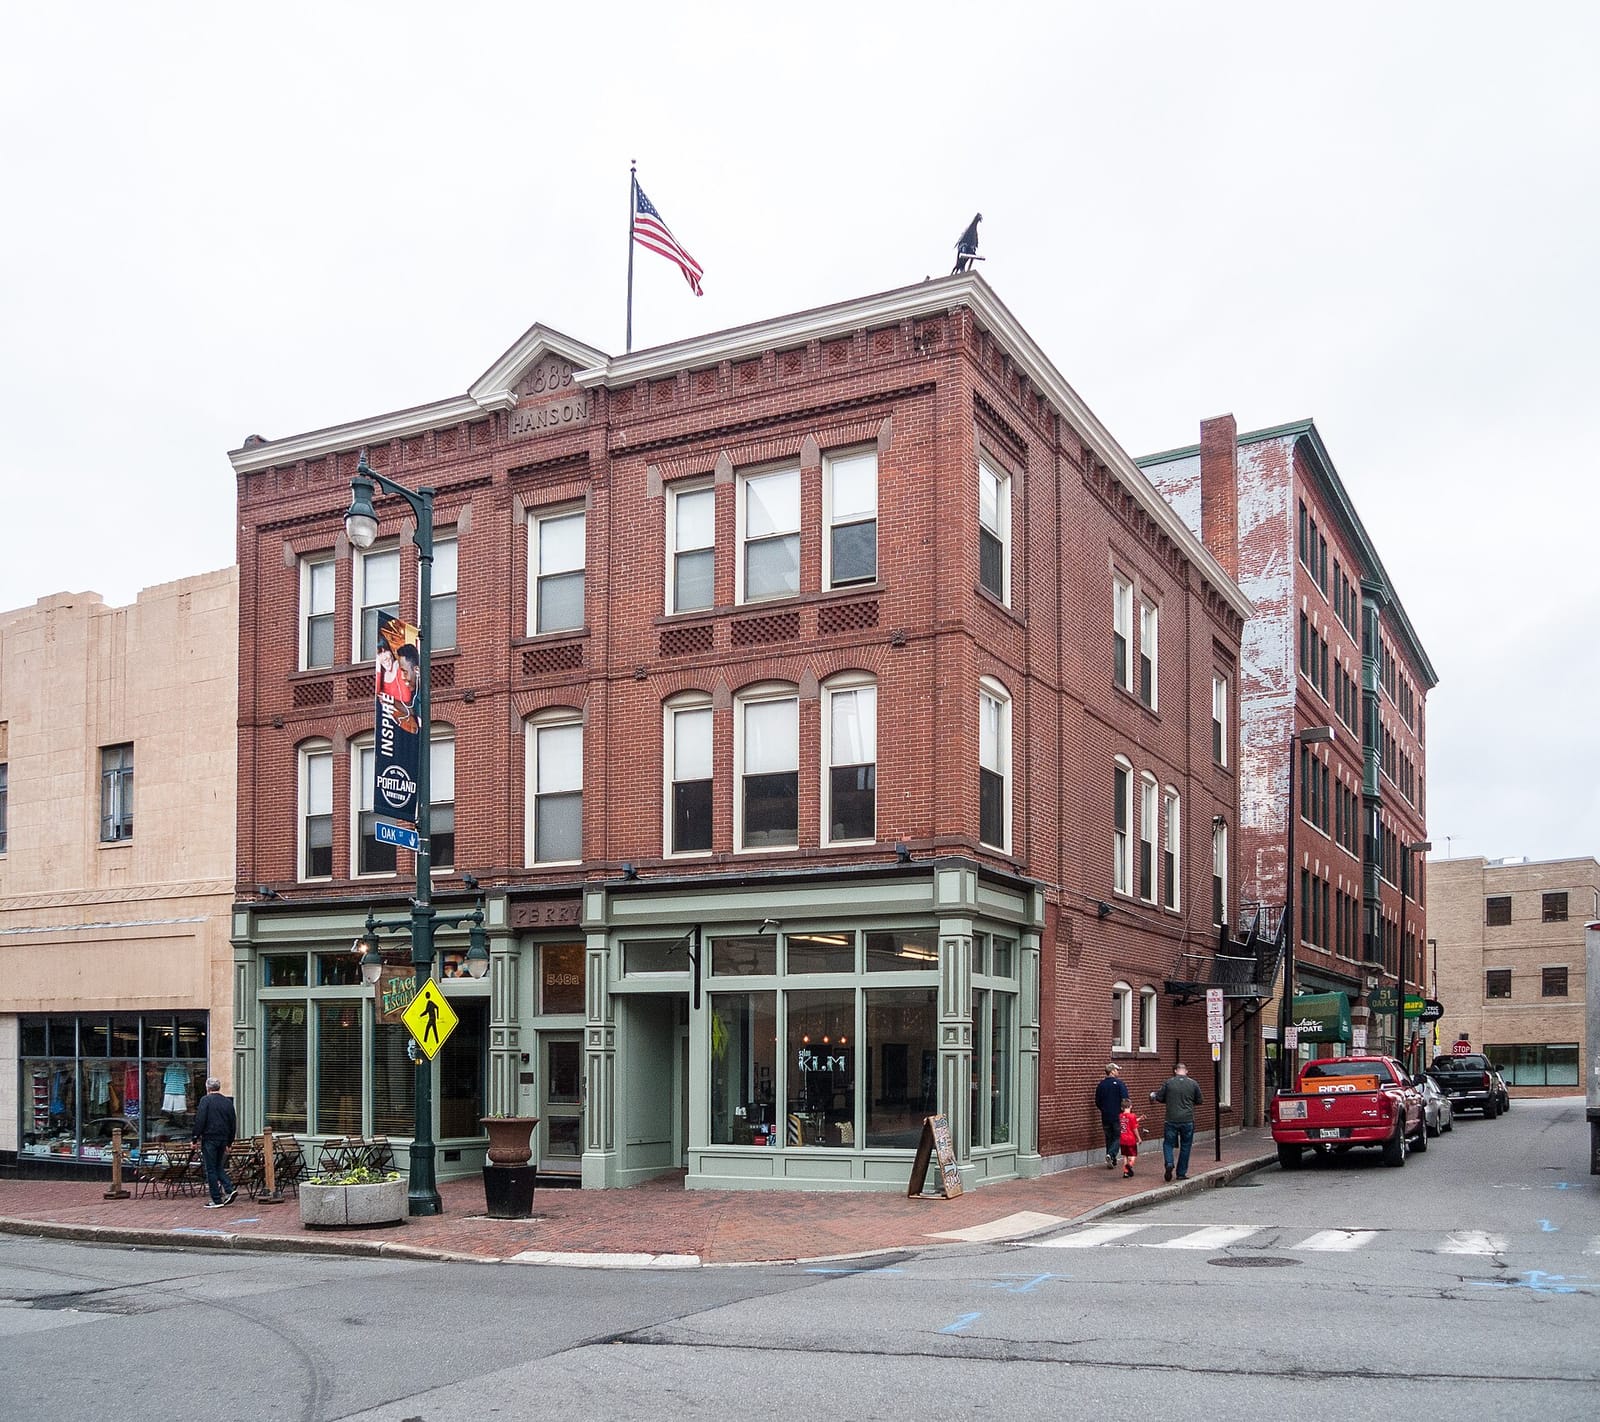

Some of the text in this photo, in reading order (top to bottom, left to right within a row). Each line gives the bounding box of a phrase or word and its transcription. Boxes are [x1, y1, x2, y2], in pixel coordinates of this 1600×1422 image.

[523, 364, 573, 395] 1889
[512, 401, 588, 434] HANSON
[381, 692, 395, 757] INSPIRE
[376, 775, 416, 794] PORTLAND
[381, 826, 397, 841] OAK
[515, 904, 582, 924] PERRY
[1371, 1000, 1387, 1008] OAK
[1380, 990, 1391, 999] 51
[1453, 1045, 1471, 1053] STOP
